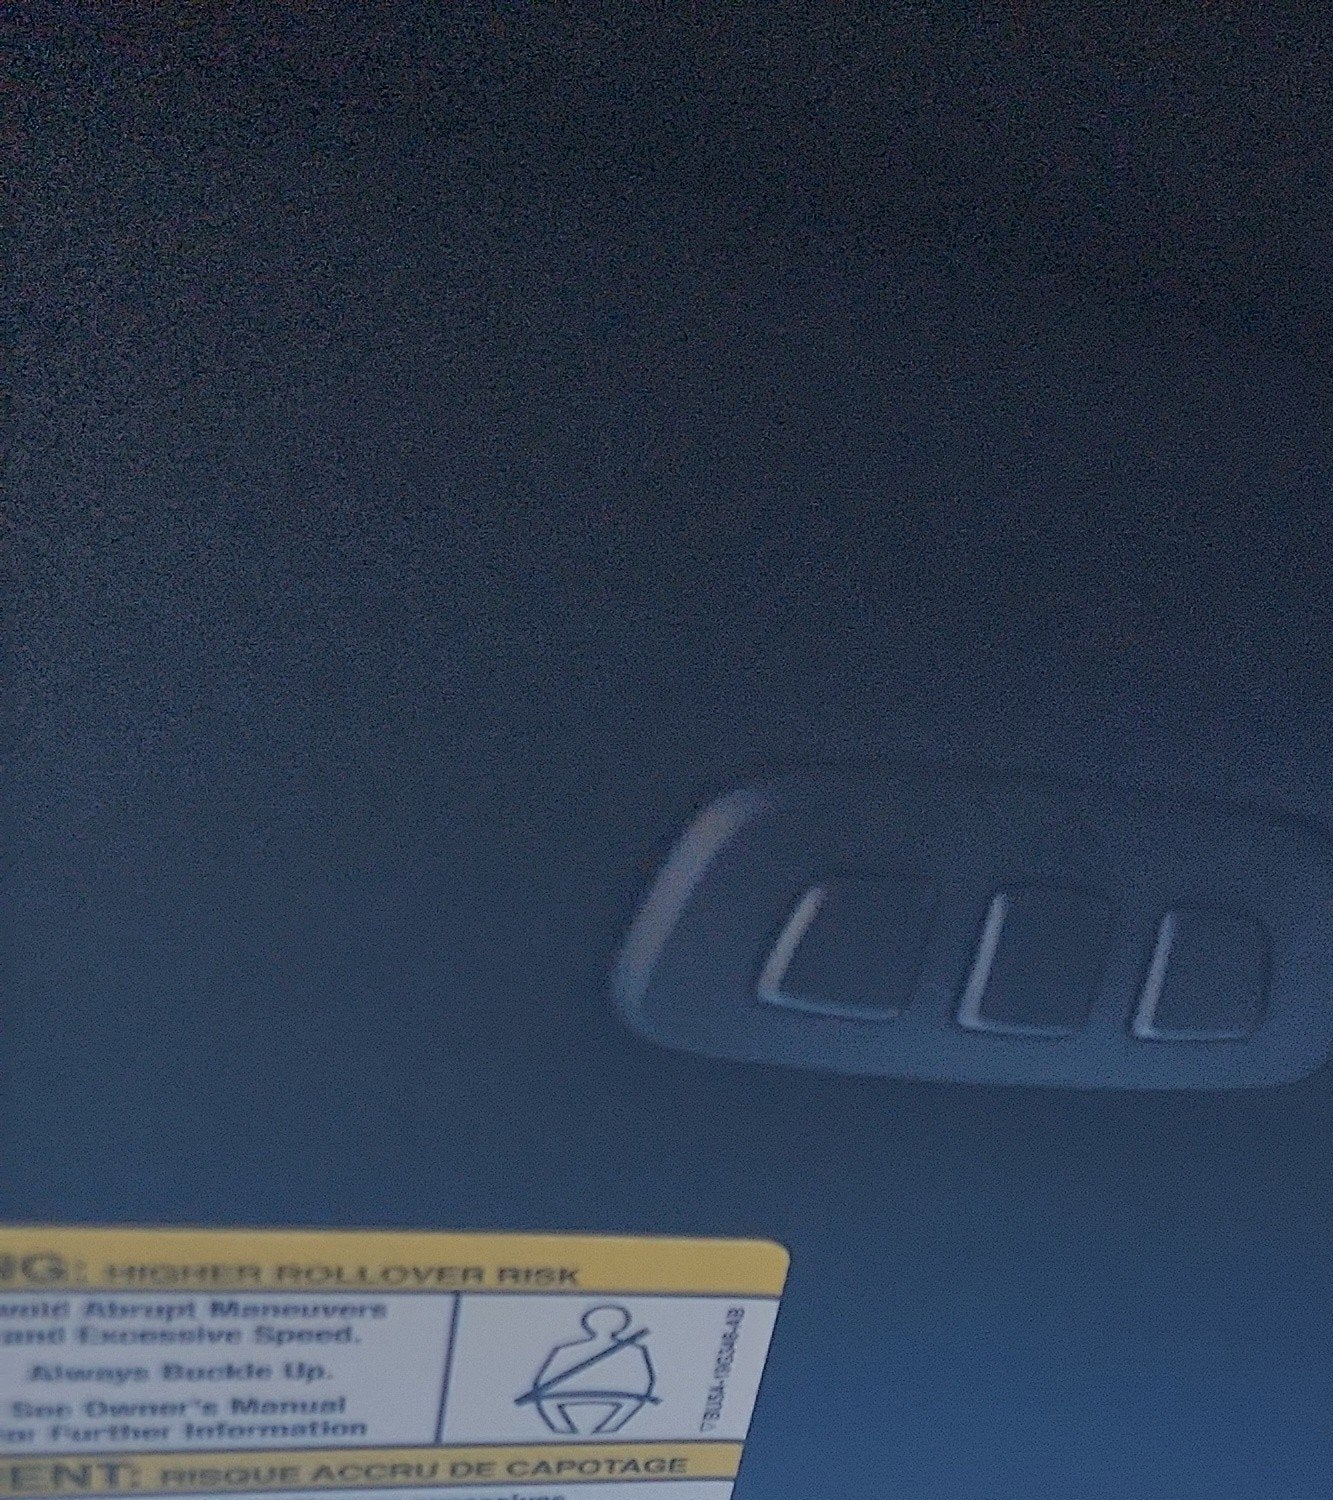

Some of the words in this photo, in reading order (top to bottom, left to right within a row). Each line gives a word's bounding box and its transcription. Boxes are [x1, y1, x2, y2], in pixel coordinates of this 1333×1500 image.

[106, 1264, 261, 1284] HIGHER
[275, 1263, 485, 1286] ROLLOVER
[498, 1267, 580, 1286] RISK
[83, 1301, 198, 1321] Abrupt
[209, 1301, 388, 1319] Maneuvers
[3, 1326, 66, 1344] and
[76, 1326, 242, 1344] Excessive
[254, 1325, 362, 1346] Speed.
[30, 1364, 149, 1384] Always
[162, 1362, 272, 1383] Buckle
[283, 1362, 333, 1384] Up.
[84, 1399, 218, 1418] Owner's
[231, 1396, 347, 1415] Manual
[50, 1423, 170, 1442] Further
[185, 1421, 368, 1439] Information
[0, 1463, 140, 1490] ENT:
[160, 1466, 300, 1487] RISQUE
[309, 1462, 439, 1483] ACCRU
[450, 1461, 497, 1479] DE
[506, 1457, 689, 1477] CAPOTAGE
